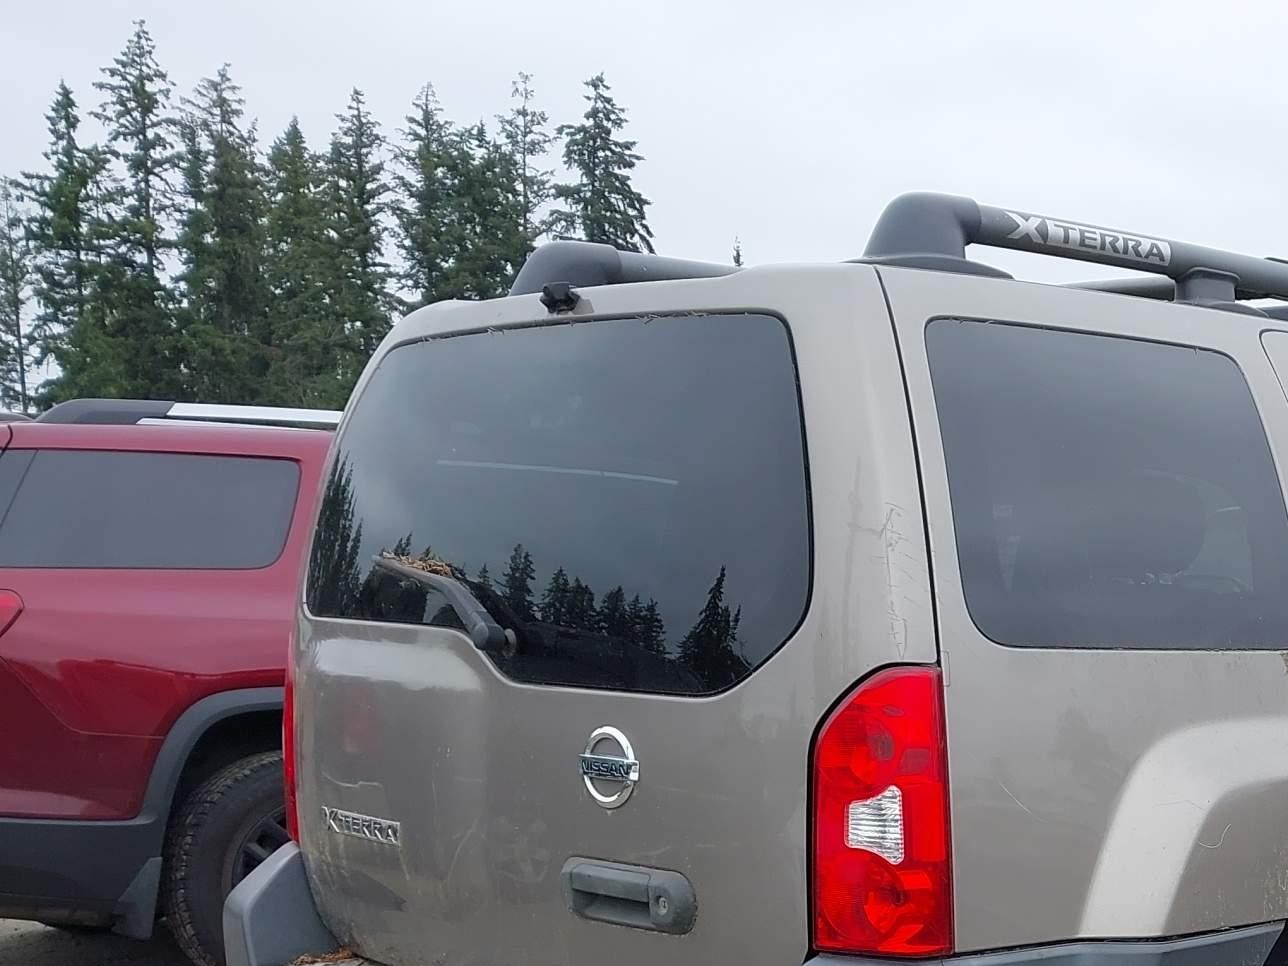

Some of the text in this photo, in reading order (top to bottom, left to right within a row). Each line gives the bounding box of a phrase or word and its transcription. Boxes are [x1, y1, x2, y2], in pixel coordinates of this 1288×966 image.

[1002, 211, 1171, 266] XTERRA
[581, 760, 632, 777] NISSAN
[321, 806, 401, 846] XTERRA
